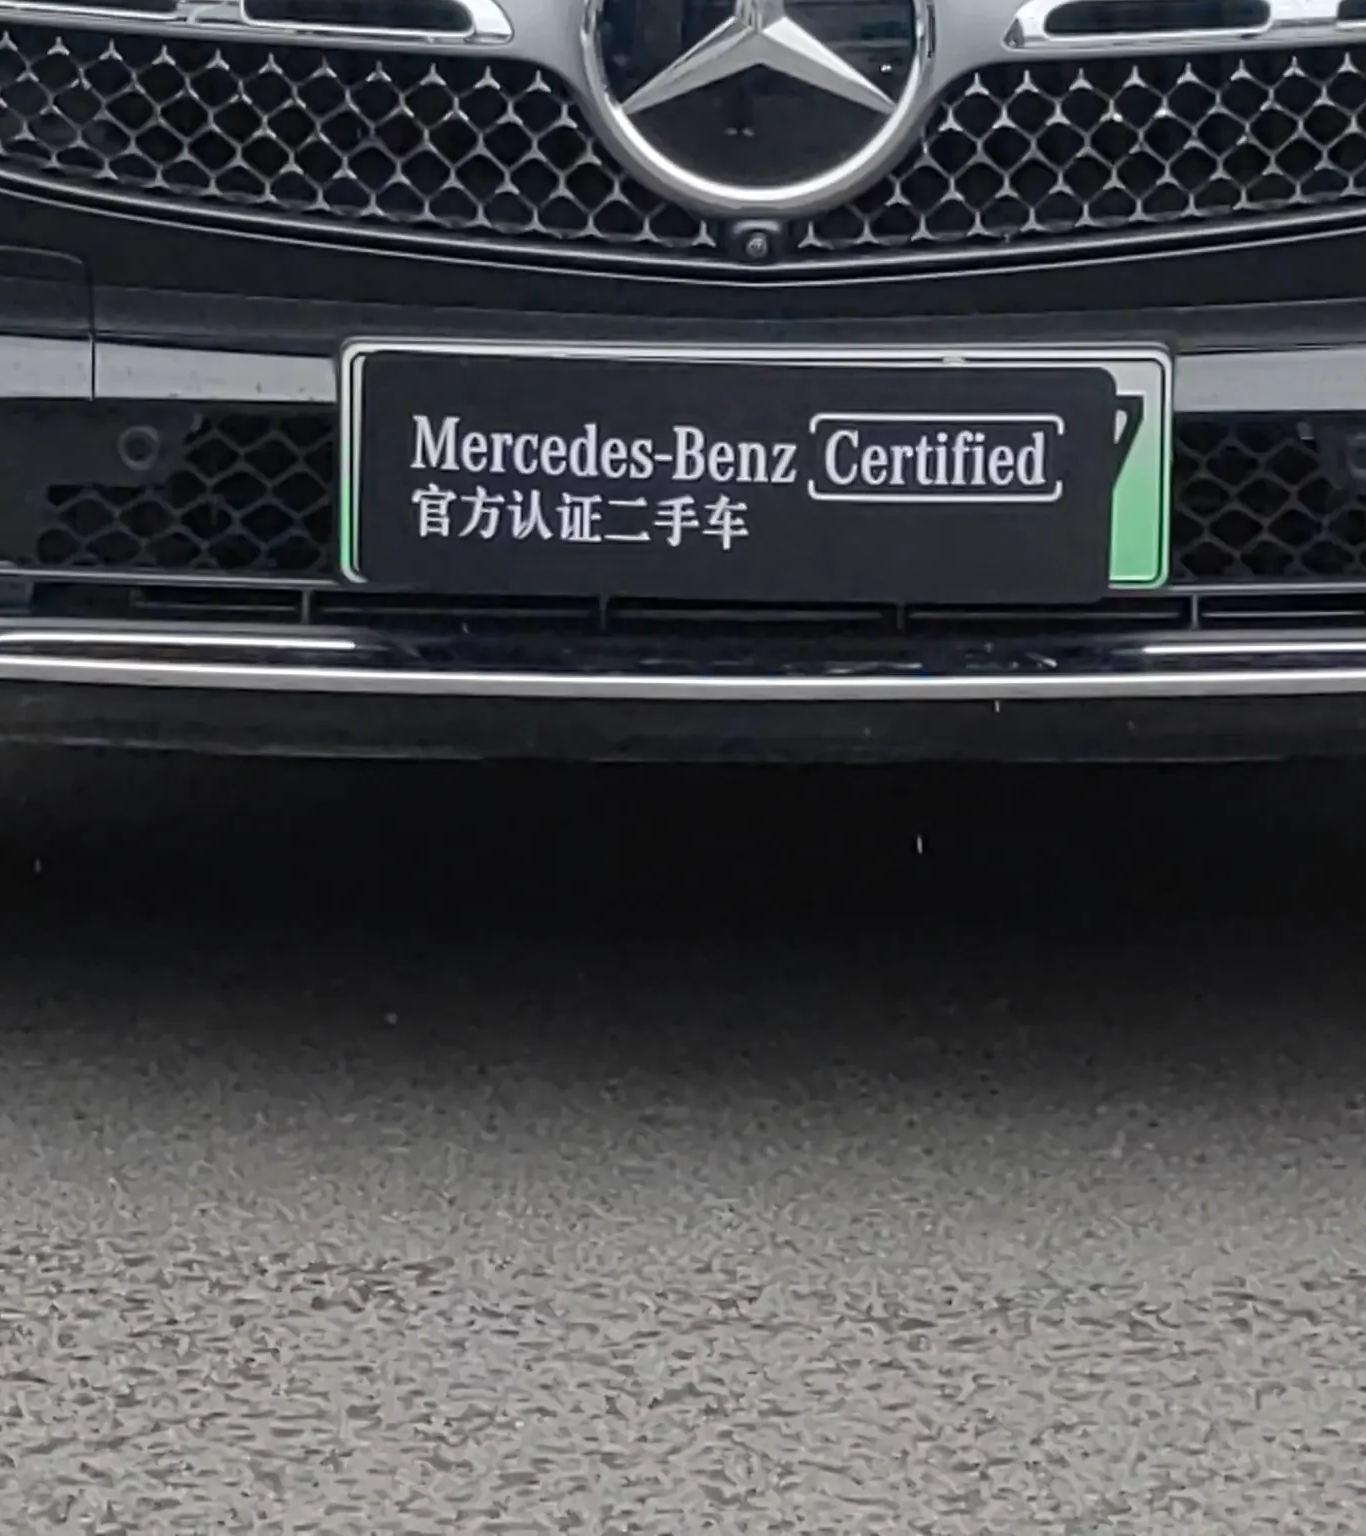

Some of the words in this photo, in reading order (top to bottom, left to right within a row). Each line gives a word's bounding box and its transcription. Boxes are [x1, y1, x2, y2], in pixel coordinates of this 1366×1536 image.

[410, 414, 798, 484] Mercedes-Benz
[825, 429, 1046, 486] Certified
[411, 482, 750, 551] 官方认证二手车
